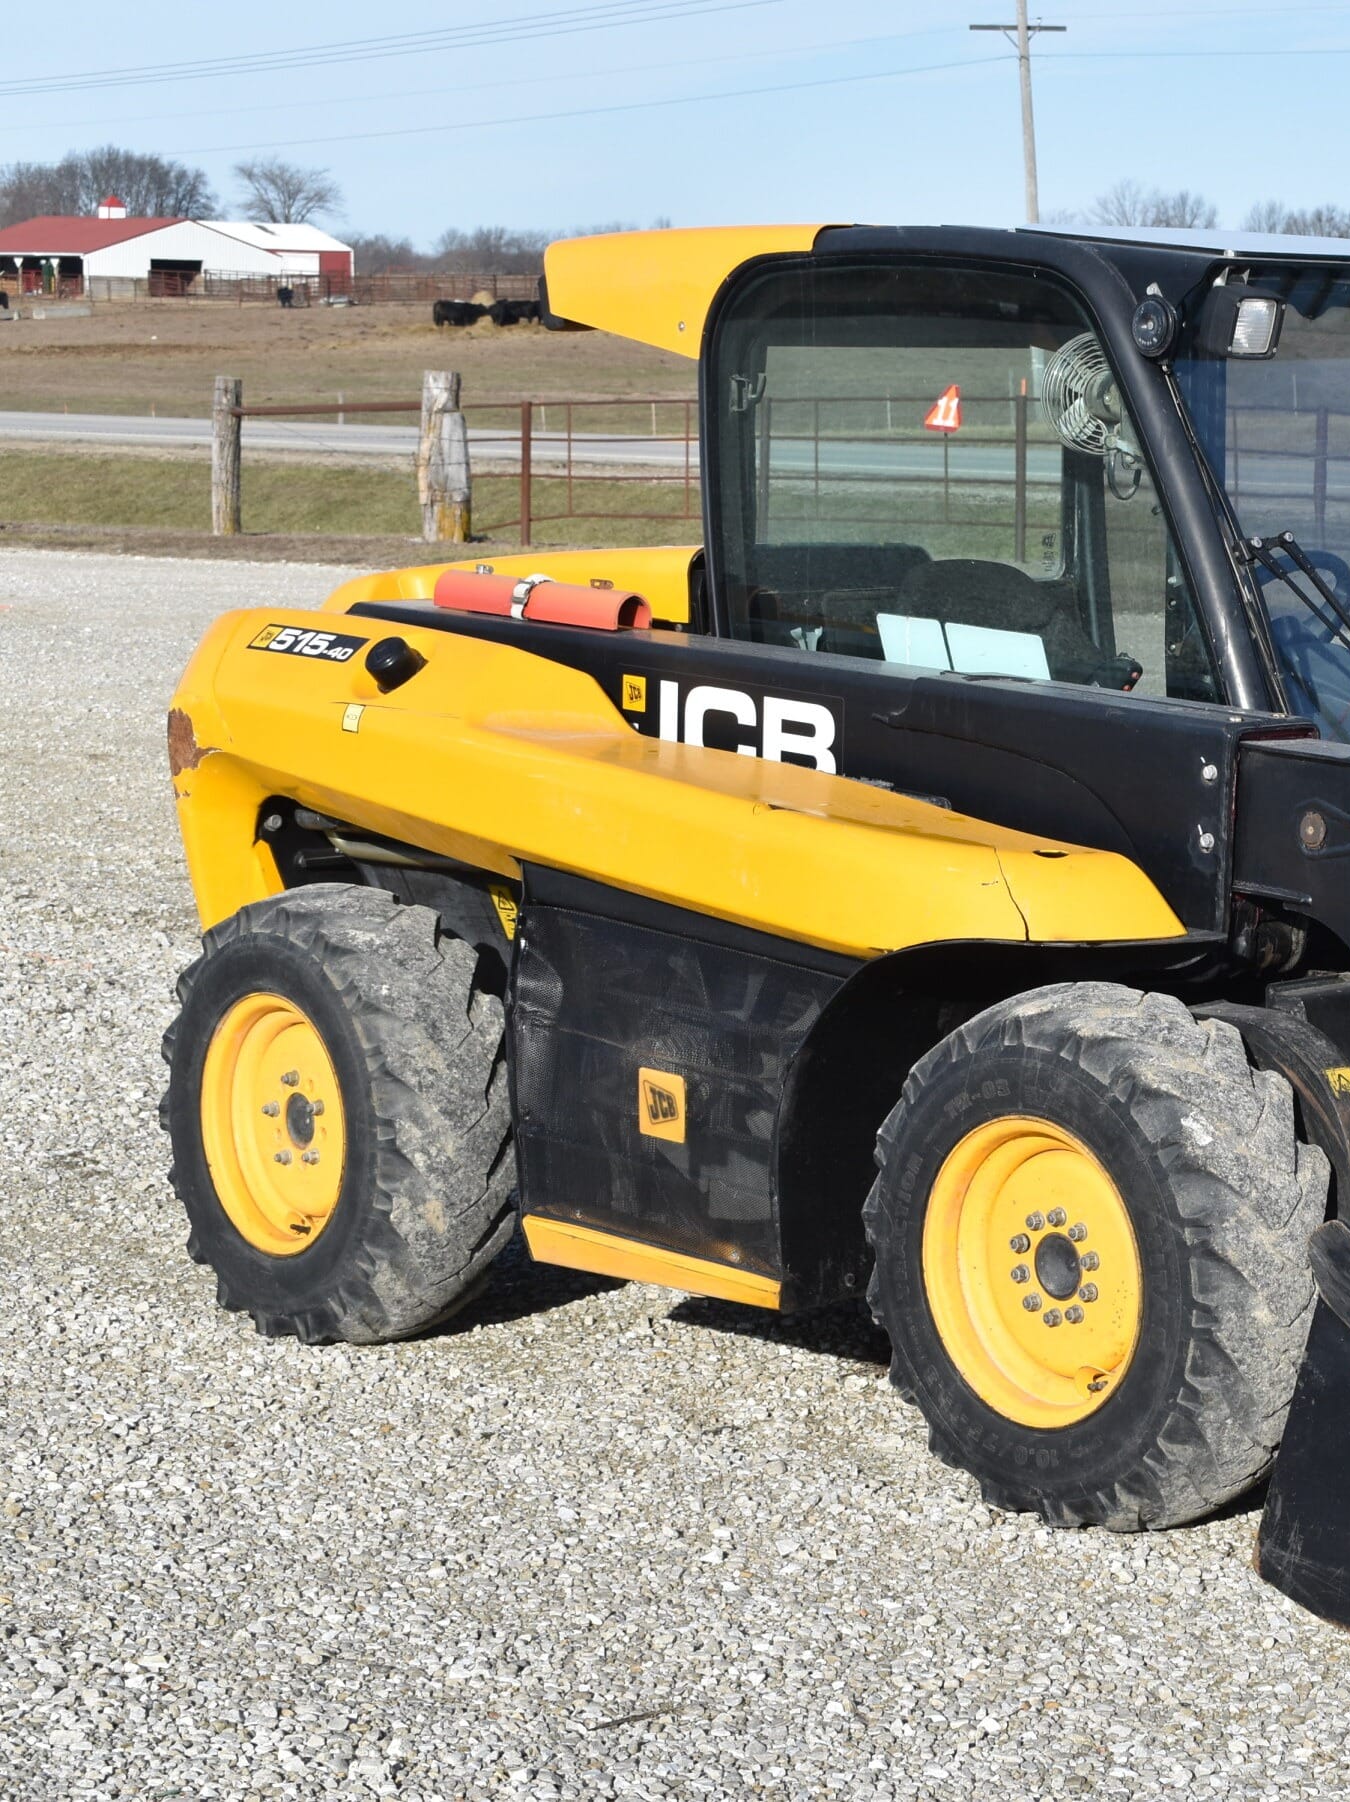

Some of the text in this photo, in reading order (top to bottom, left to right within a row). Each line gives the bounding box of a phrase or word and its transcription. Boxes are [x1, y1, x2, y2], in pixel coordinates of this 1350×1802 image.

[932, 397, 959, 427] 11
[268, 627, 354, 661] 515-40
[658, 679, 837, 775] JCB
[648, 1085, 677, 1121] JCB
